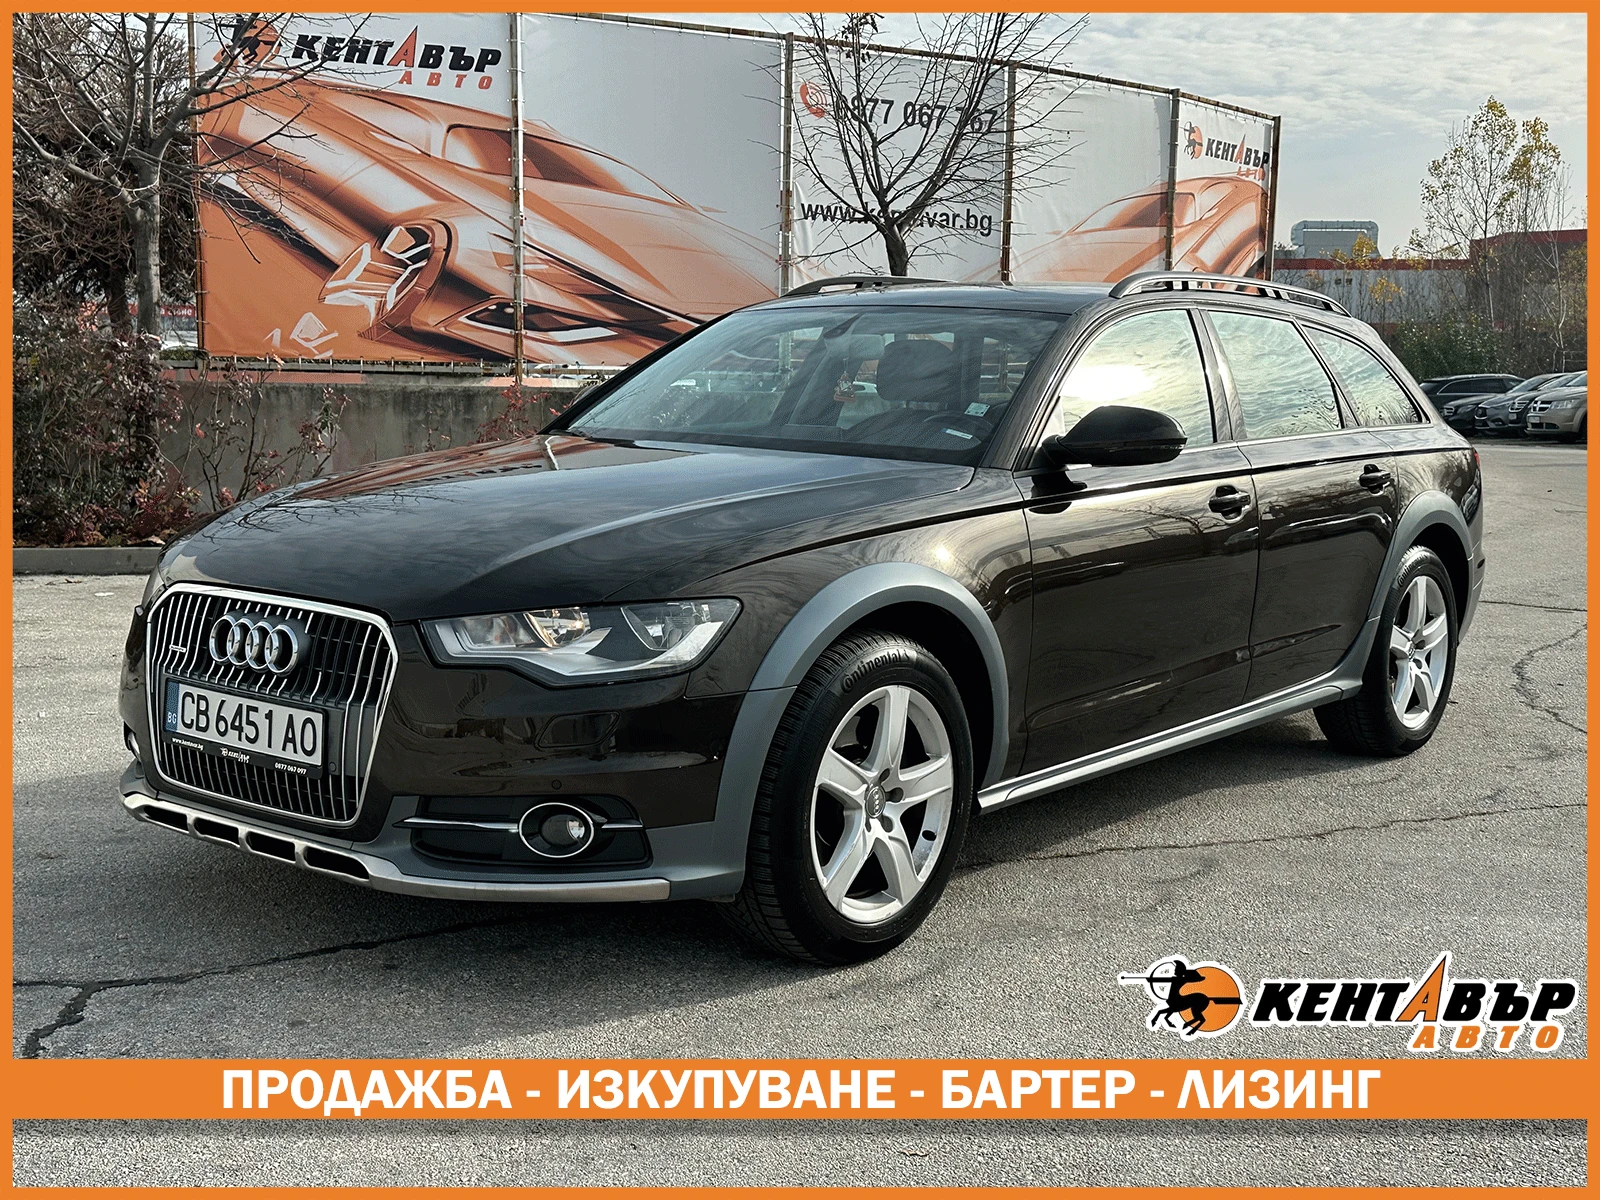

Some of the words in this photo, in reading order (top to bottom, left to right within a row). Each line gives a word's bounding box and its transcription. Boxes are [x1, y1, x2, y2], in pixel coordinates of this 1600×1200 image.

[291, 25, 502, 73] КЕНТАВЪР
[398, 70, 493, 90] АВТО
[903, 101, 947, 129] 067
[1205, 133, 1270, 168] КЕНТАВЪР
[841, 648, 902, 694] Continental
[167, 711, 177, 724] BG
[181, 691, 210, 733] CB
[215, 699, 273, 749] 6451
[281, 713, 317, 757] AO
